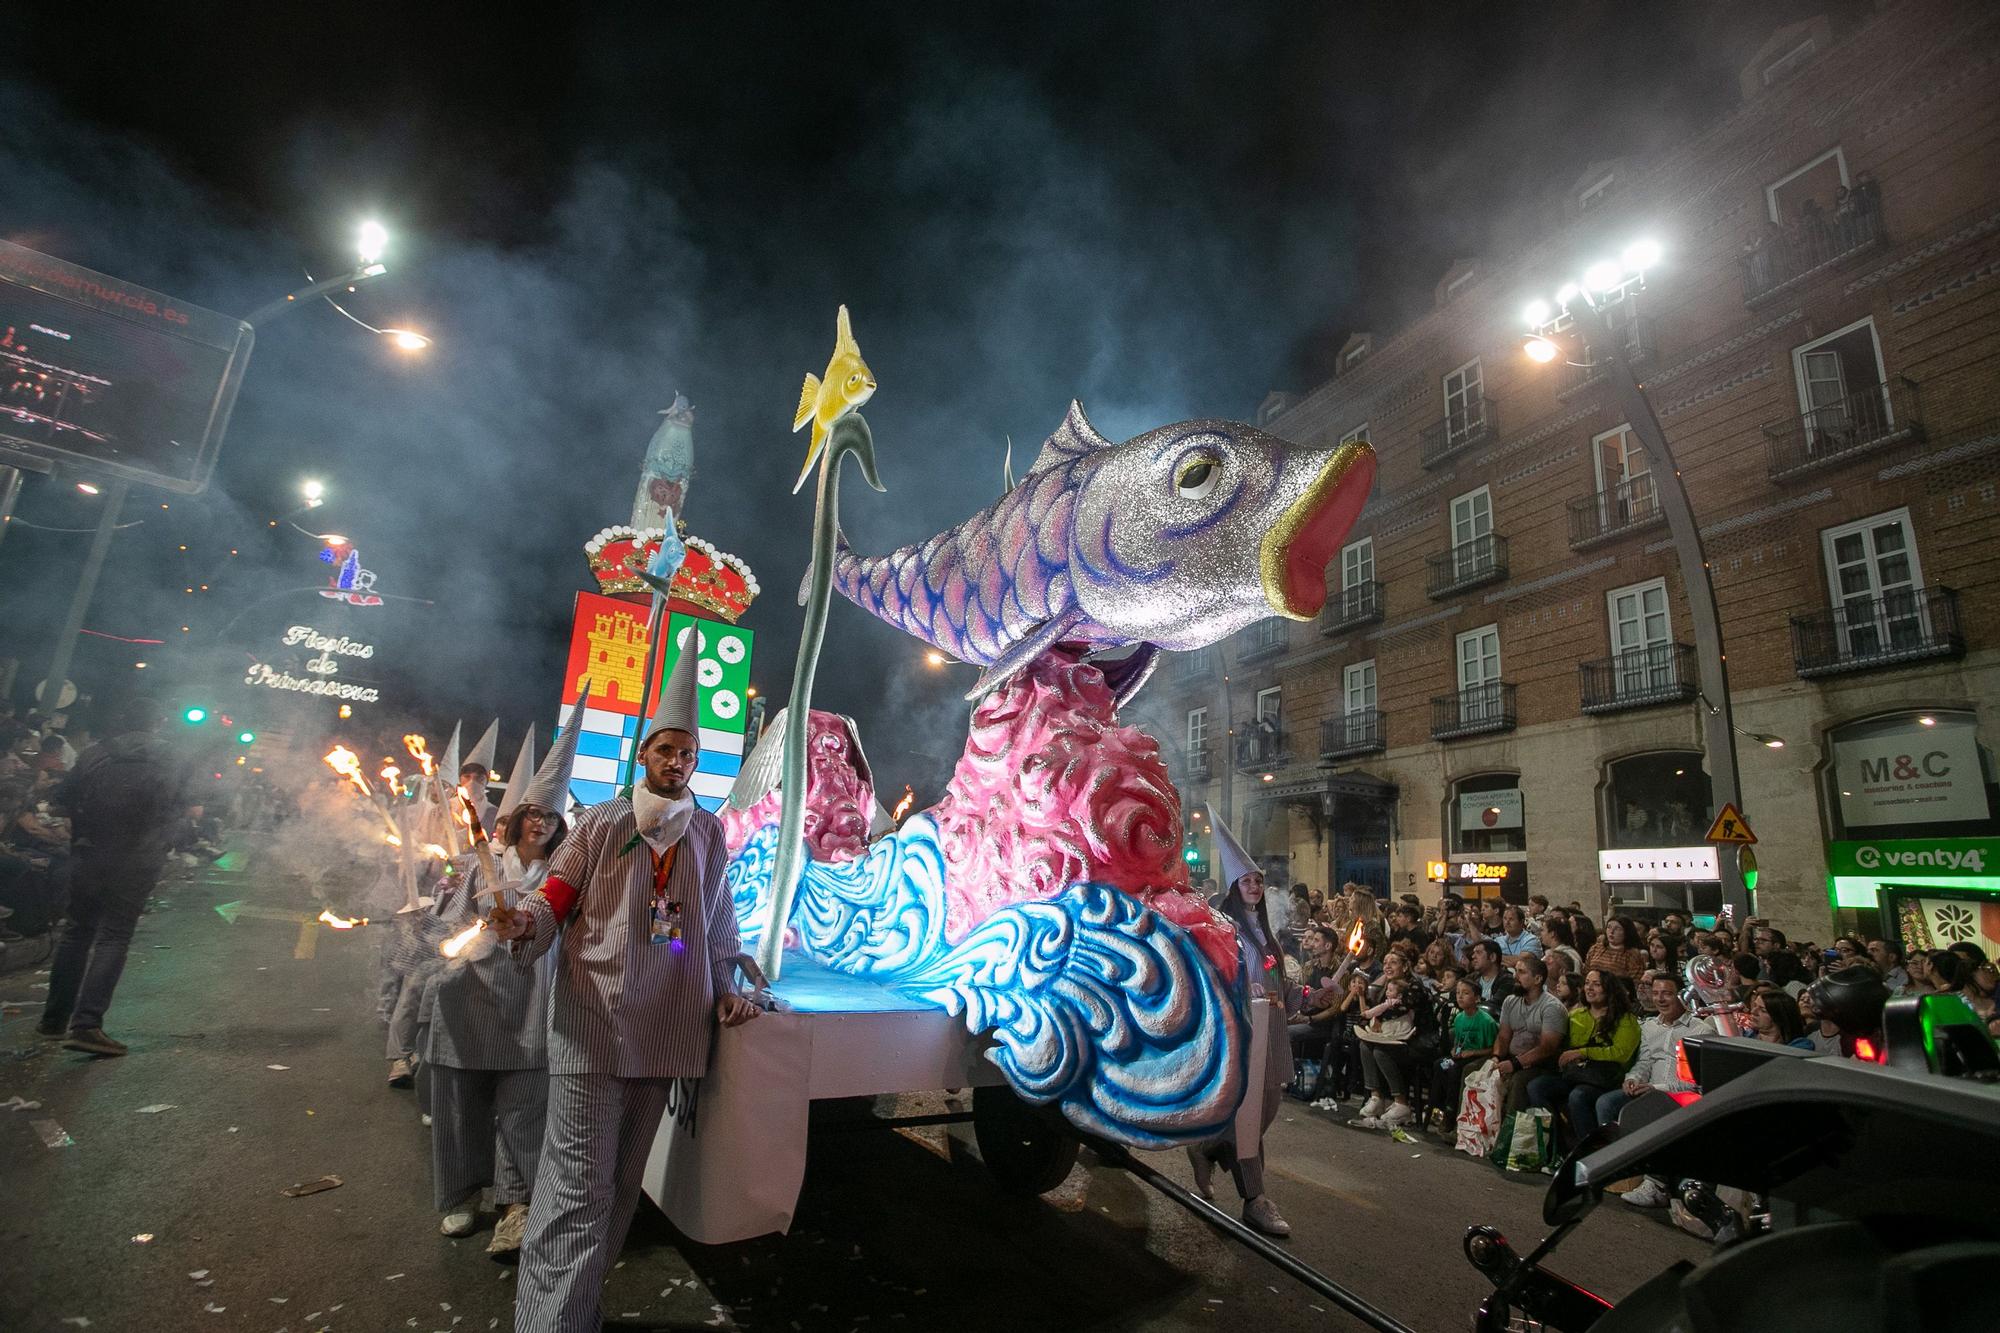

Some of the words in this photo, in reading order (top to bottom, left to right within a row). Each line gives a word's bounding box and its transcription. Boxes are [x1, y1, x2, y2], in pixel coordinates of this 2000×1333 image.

[282, 625, 374, 659] Fiestas
[306, 652, 339, 675] de
[244, 663, 379, 702] Primavera
[1860, 751, 1951, 784] M&C
[1460, 862, 1508, 878] BitBase
